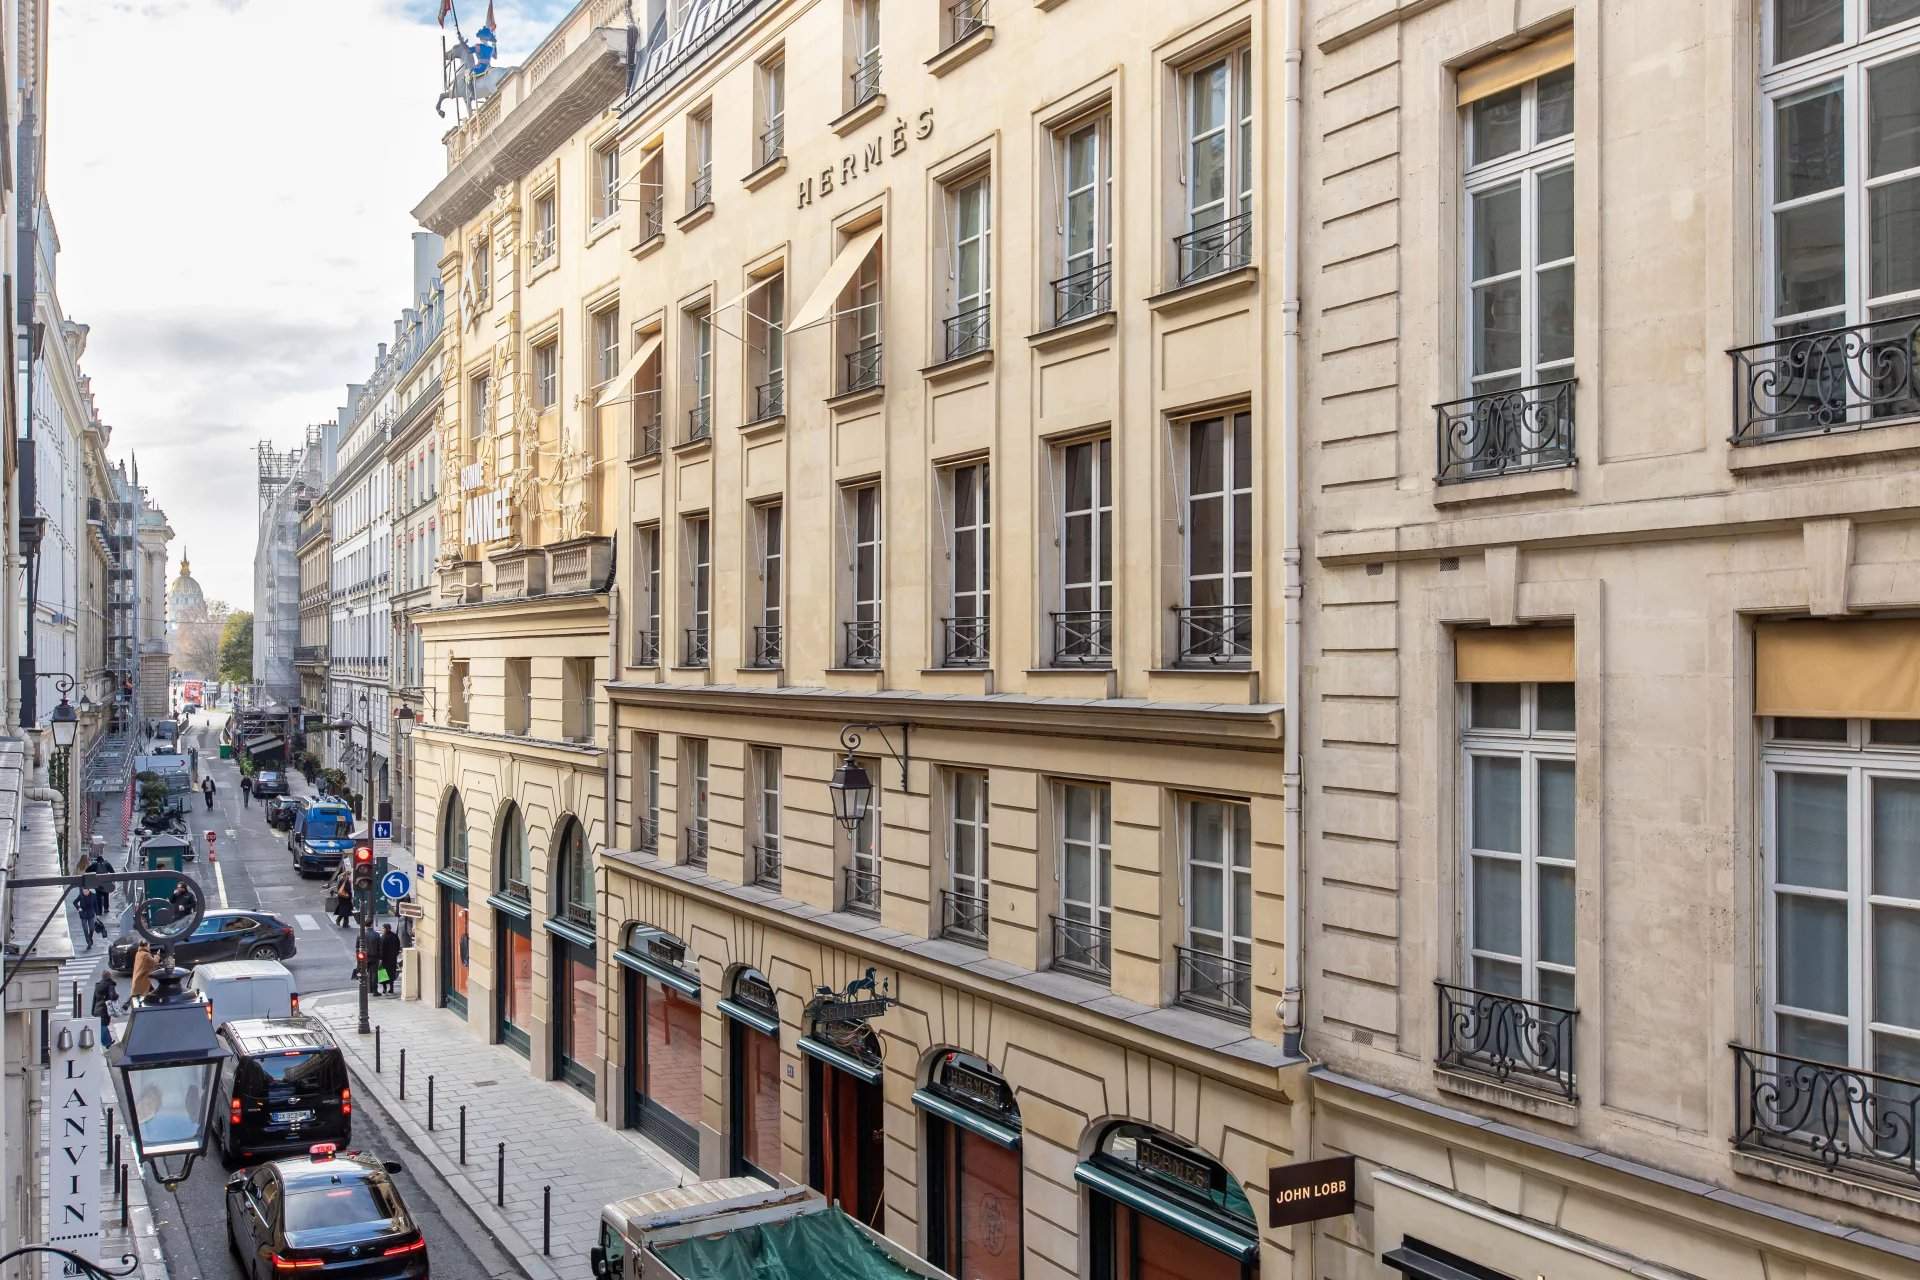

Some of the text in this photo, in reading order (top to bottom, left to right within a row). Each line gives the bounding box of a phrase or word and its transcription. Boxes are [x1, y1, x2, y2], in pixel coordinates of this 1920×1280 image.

[797, 107, 934, 209] HERMÈS
[62, 1059, 88, 1225] LANVIN
[1276, 1180, 1346, 1204] JOHN LOBB
